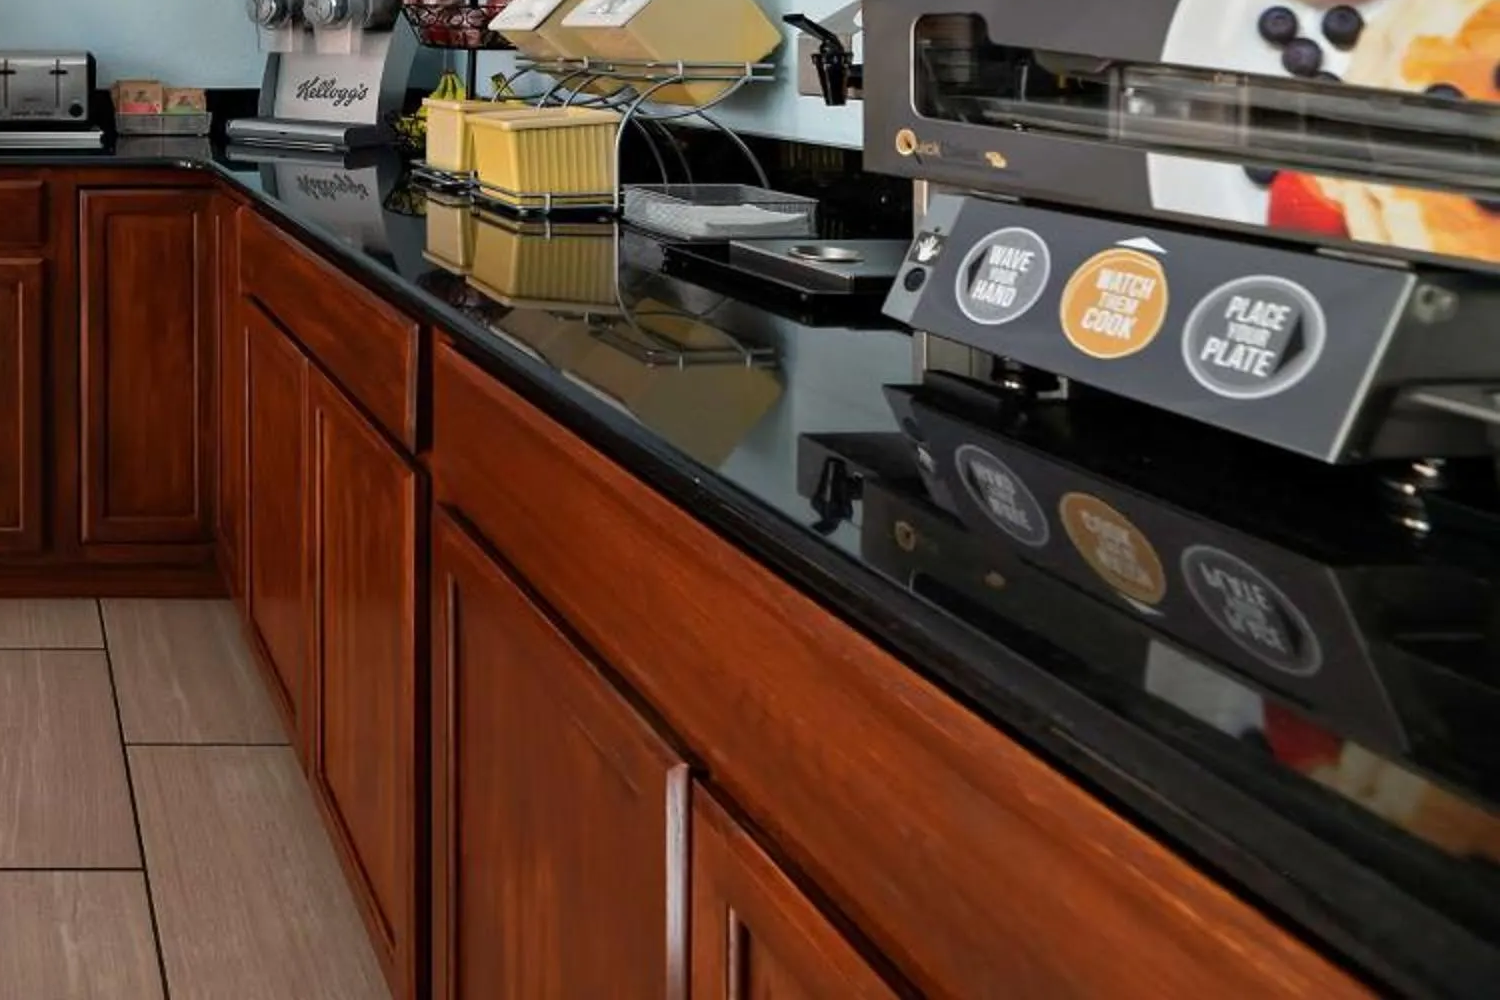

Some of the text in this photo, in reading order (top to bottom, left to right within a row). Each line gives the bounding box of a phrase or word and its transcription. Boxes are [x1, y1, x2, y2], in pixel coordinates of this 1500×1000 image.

[296, 75, 369, 107] Kellogg's
[988, 244, 1035, 272] WAVE
[971, 279, 1017, 308] HAND
[1096, 267, 1156, 302] WATCH
[1098, 290, 1139, 315] THEM
[1224, 295, 1292, 332] PLACE
[1080, 307, 1139, 340] COOK
[1227, 320, 1272, 348] YOUR
[1201, 336, 1276, 378] PLATE
